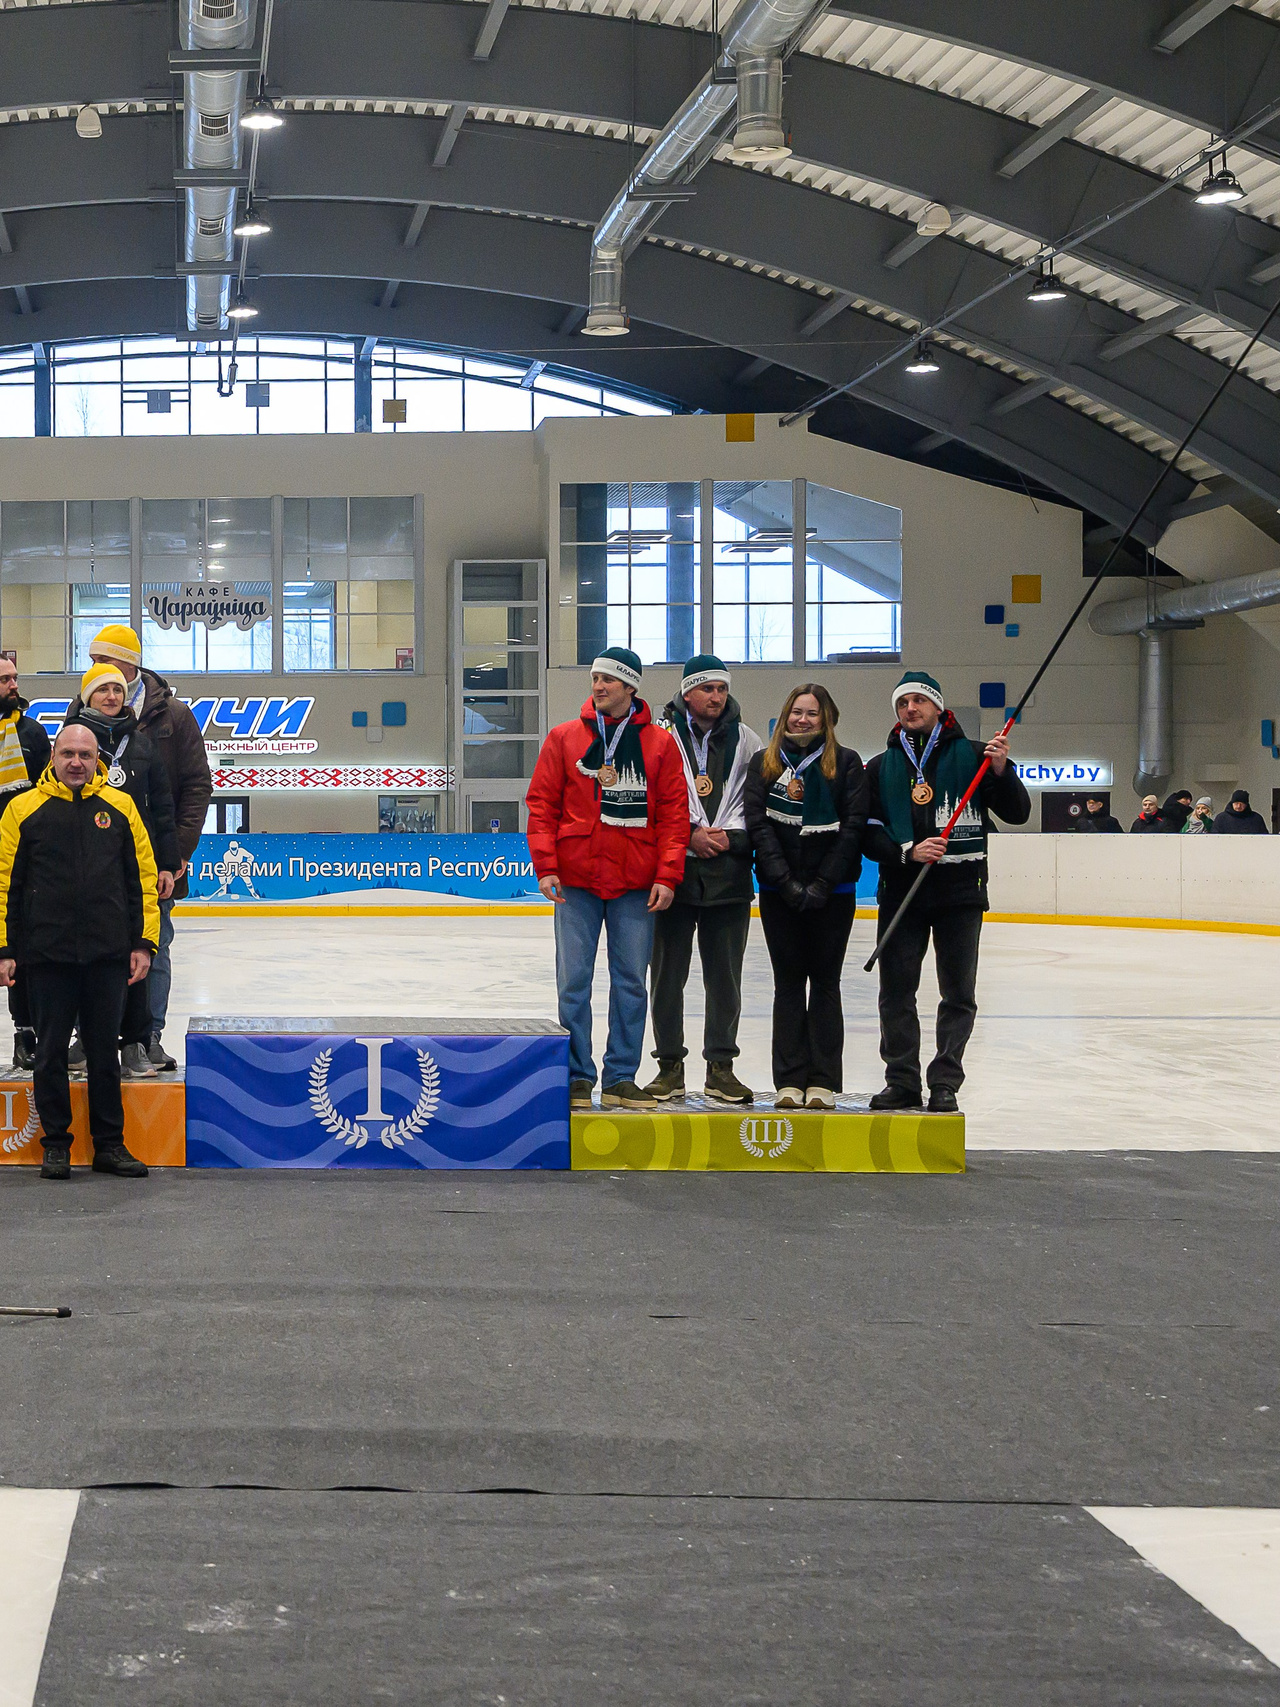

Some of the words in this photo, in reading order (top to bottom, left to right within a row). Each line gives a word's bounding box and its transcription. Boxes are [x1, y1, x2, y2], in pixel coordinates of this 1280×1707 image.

[186, 587, 230, 597] КАФЕ
[149, 596, 267, 626] Чараўніца
[271, 742, 316, 754] ЦЕНТР
[199, 862, 282, 881] делами
[289, 856, 422, 881] Президента
[428, 856, 534, 882] Республи
[355, 1037, 394, 1121] I
[749, 1119, 785, 1143] III
